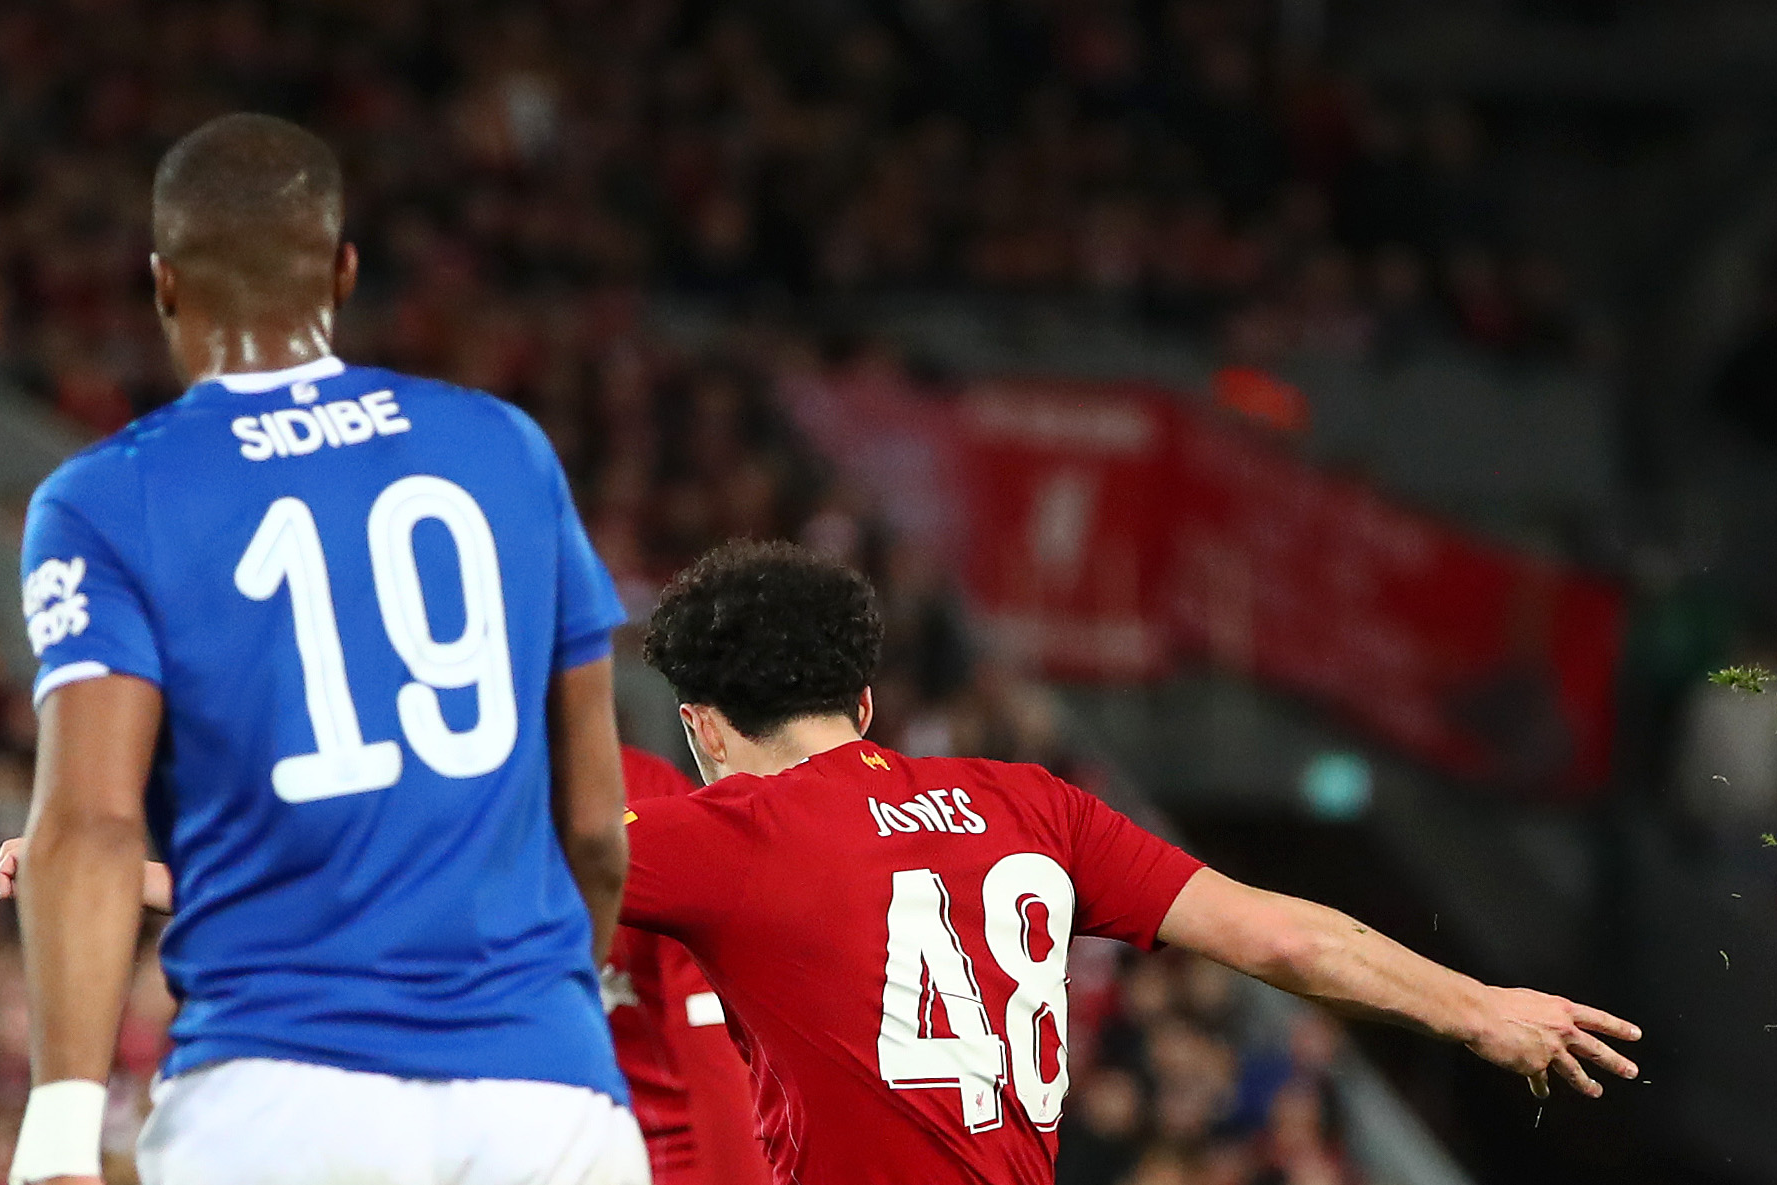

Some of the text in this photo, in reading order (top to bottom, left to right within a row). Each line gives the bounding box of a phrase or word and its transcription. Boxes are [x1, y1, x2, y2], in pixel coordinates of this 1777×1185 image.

[231, 390, 412, 461] SIDIBE
[234, 475, 519, 804] 19
[868, 787, 988, 837] JONES
[878, 853, 1075, 1134] 48
